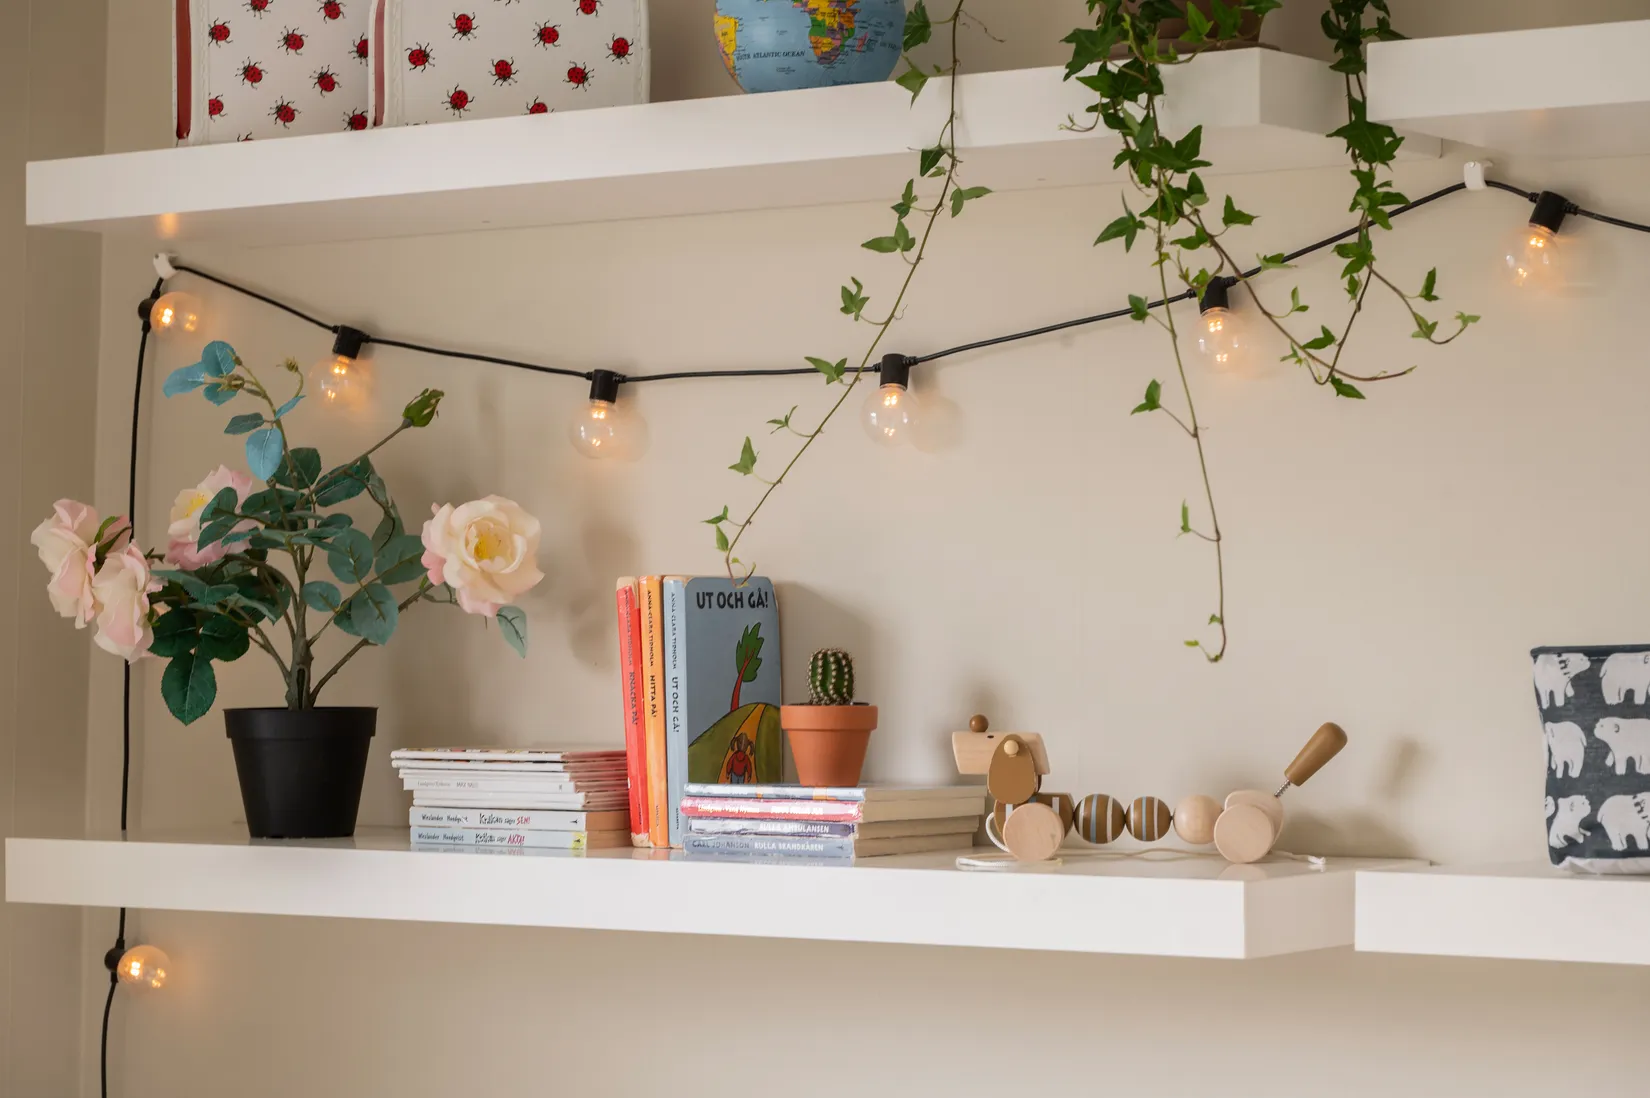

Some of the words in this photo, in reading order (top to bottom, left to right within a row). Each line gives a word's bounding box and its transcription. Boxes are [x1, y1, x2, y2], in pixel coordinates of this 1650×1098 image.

[752, 50, 781, 59] ATLANTIC
[782, 49, 806, 57] OCEAN
[696, 592, 714, 609] UT
[717, 591, 744, 609] OCH
[748, 587, 768, 609] GÅ!
[629, 671, 637, 709] KNACKA
[672, 676, 679, 690] UT
[673, 716, 681, 733] GÅ!
